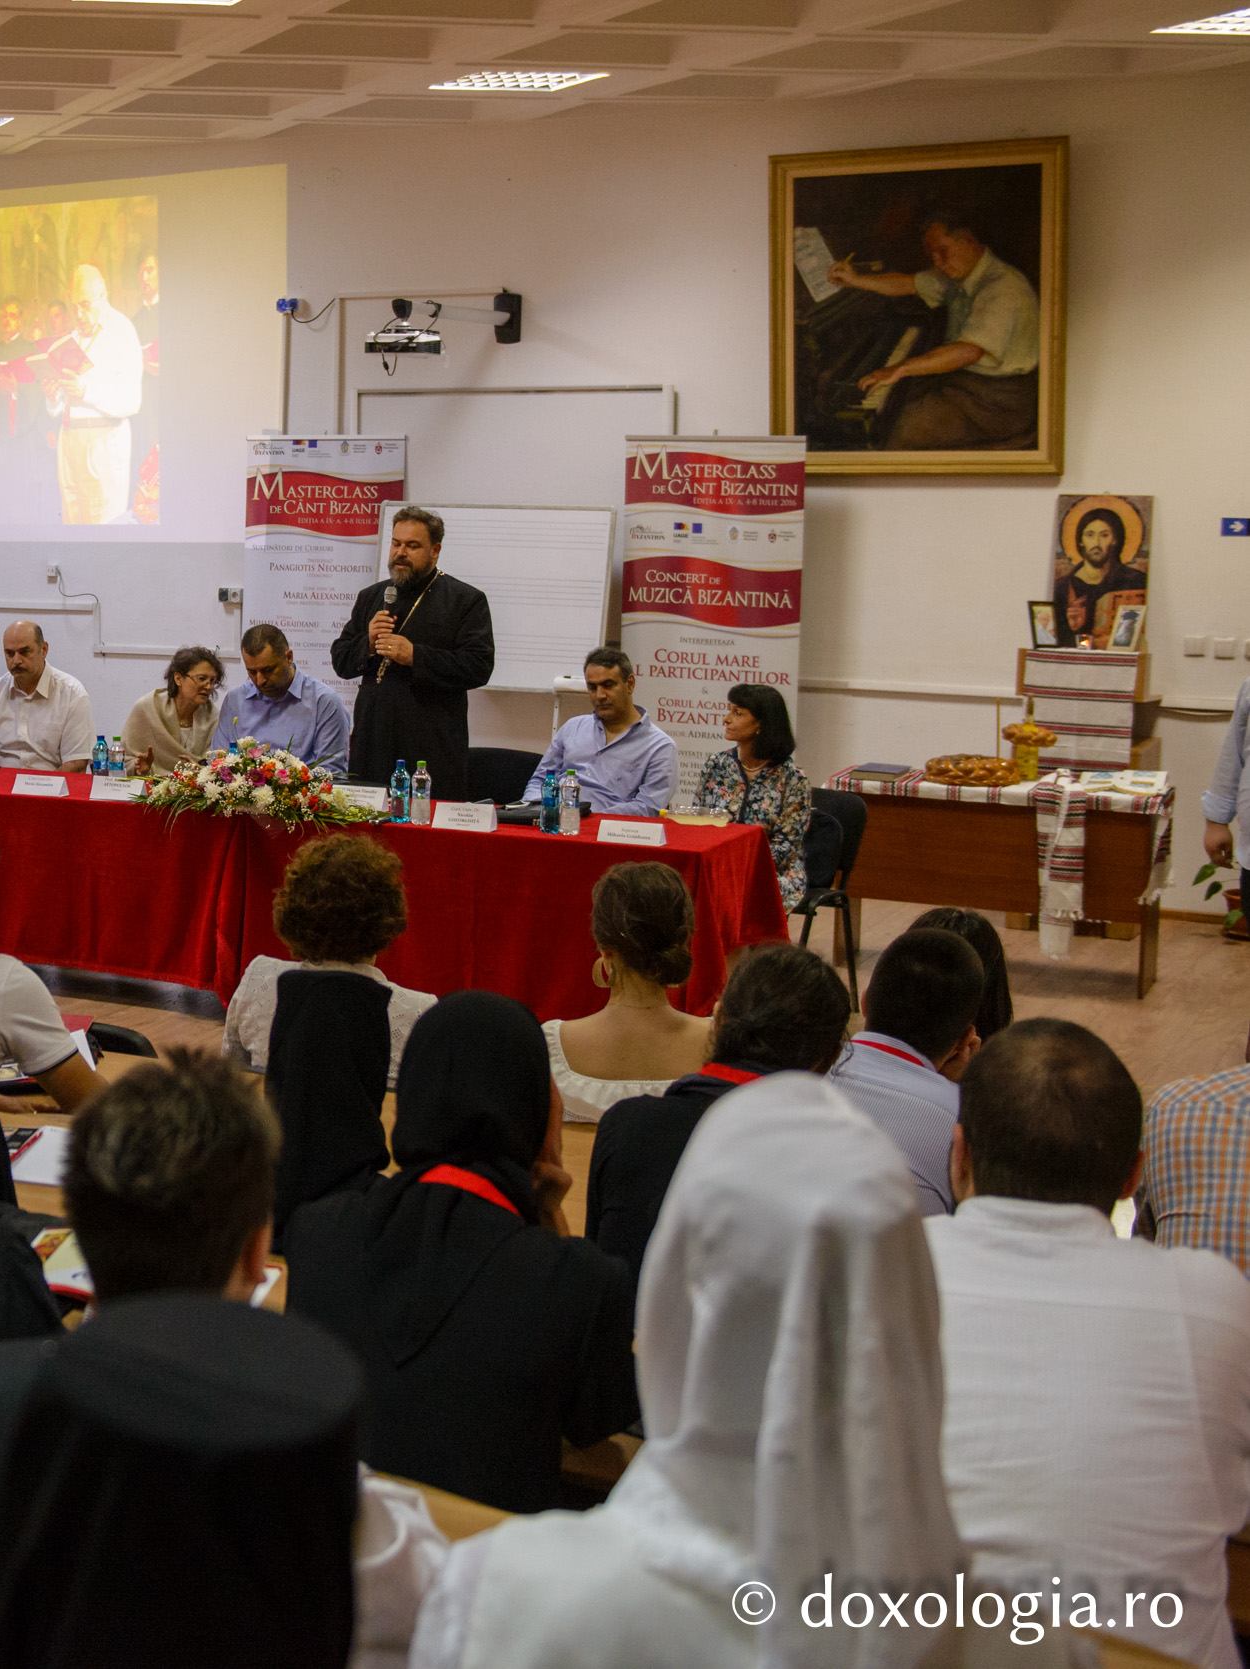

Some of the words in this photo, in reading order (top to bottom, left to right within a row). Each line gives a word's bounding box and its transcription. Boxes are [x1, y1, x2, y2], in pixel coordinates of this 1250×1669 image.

[631, 444, 776, 480] MASTERCLASS
[252, 467, 378, 500] MASTERCLASS
[652, 485, 666, 494] DE
[667, 478, 716, 496] CÂNT
[720, 480, 798, 497] BIZANTIN
[269, 505, 282, 514] DE
[283, 499, 327, 515] CÂNT
[329, 502, 381, 515] BIZANT
[269, 562, 316, 573] PANAGIOTIS
[317, 563, 373, 574] NEOCHORITIS
[645, 569, 707, 584] CONCERT
[709, 577, 721, 585] DE
[283, 590, 308, 600] MARIA
[310, 591, 357, 601] ALEXANDRU
[628, 585, 694, 604] MUZICĂ
[697, 588, 793, 609] BIZANTINĂ
[654, 648, 710, 666] CORUL
[715, 654, 760, 668] MARE
[658, 696, 694, 708] CORUL
[656, 707, 727, 726] BYZANT
[688, 730, 723, 740] ADRIAN
